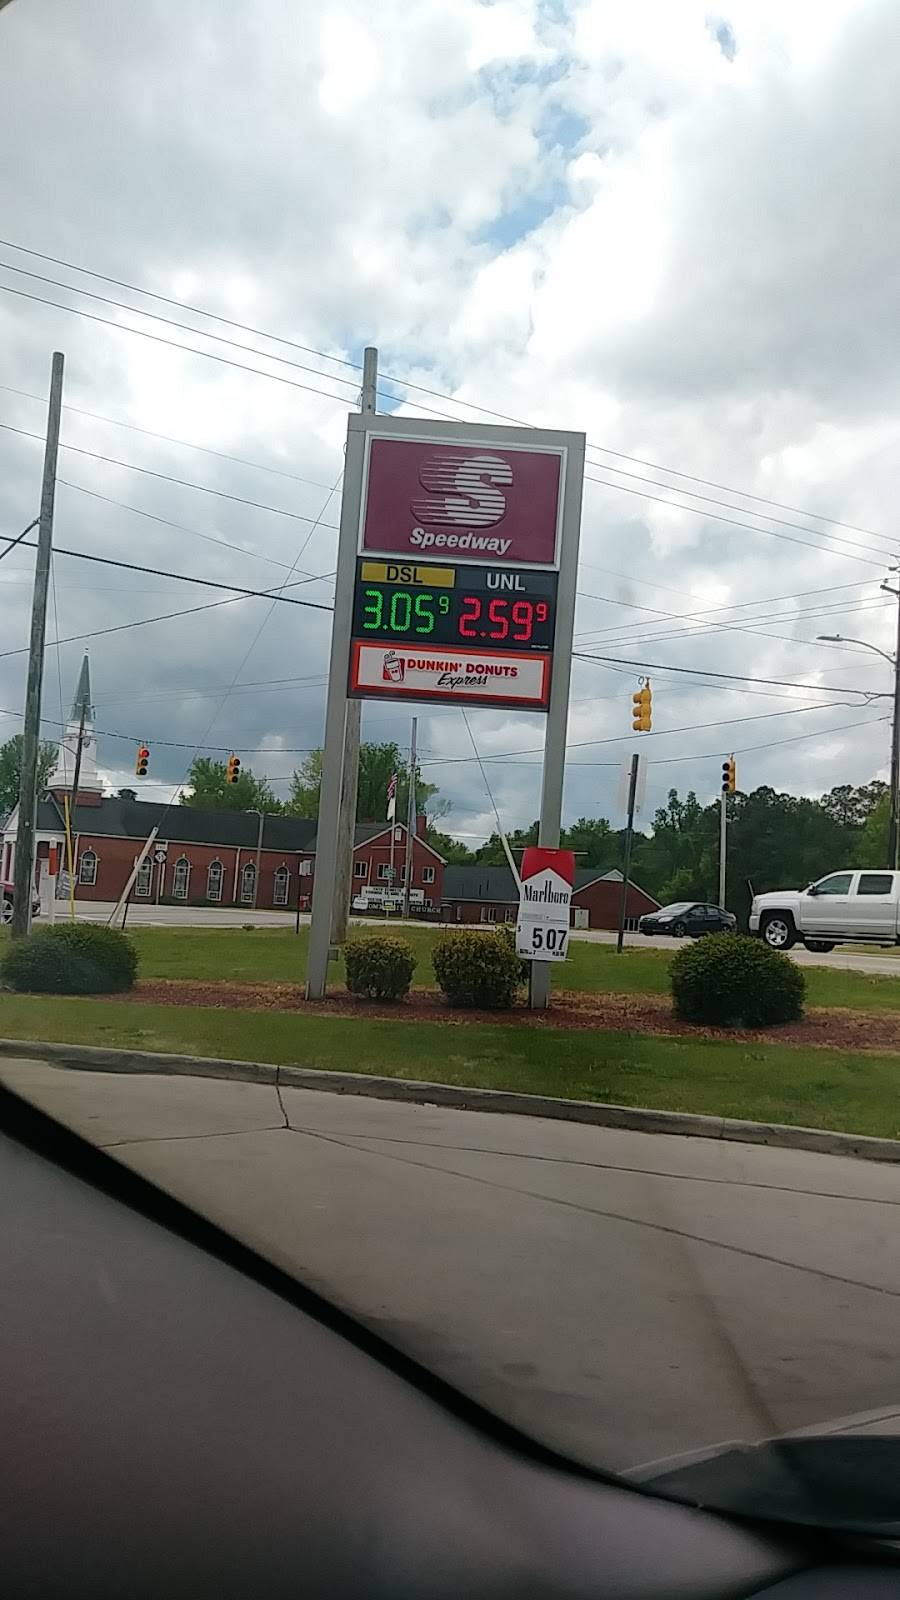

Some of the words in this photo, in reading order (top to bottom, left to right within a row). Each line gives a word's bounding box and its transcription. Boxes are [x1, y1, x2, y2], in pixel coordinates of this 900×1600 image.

[409, 527, 513, 556] Speedway
[386, 565, 424, 584] DSL
[486, 573, 526, 592] UNL
[407, 658, 462, 674] DUNKIN'
[466, 663, 518, 677] DONUTS
[437, 673, 488, 689] Express
[523, 880, 569, 905] Marlboro
[410, 905, 441, 914] CHURCH
